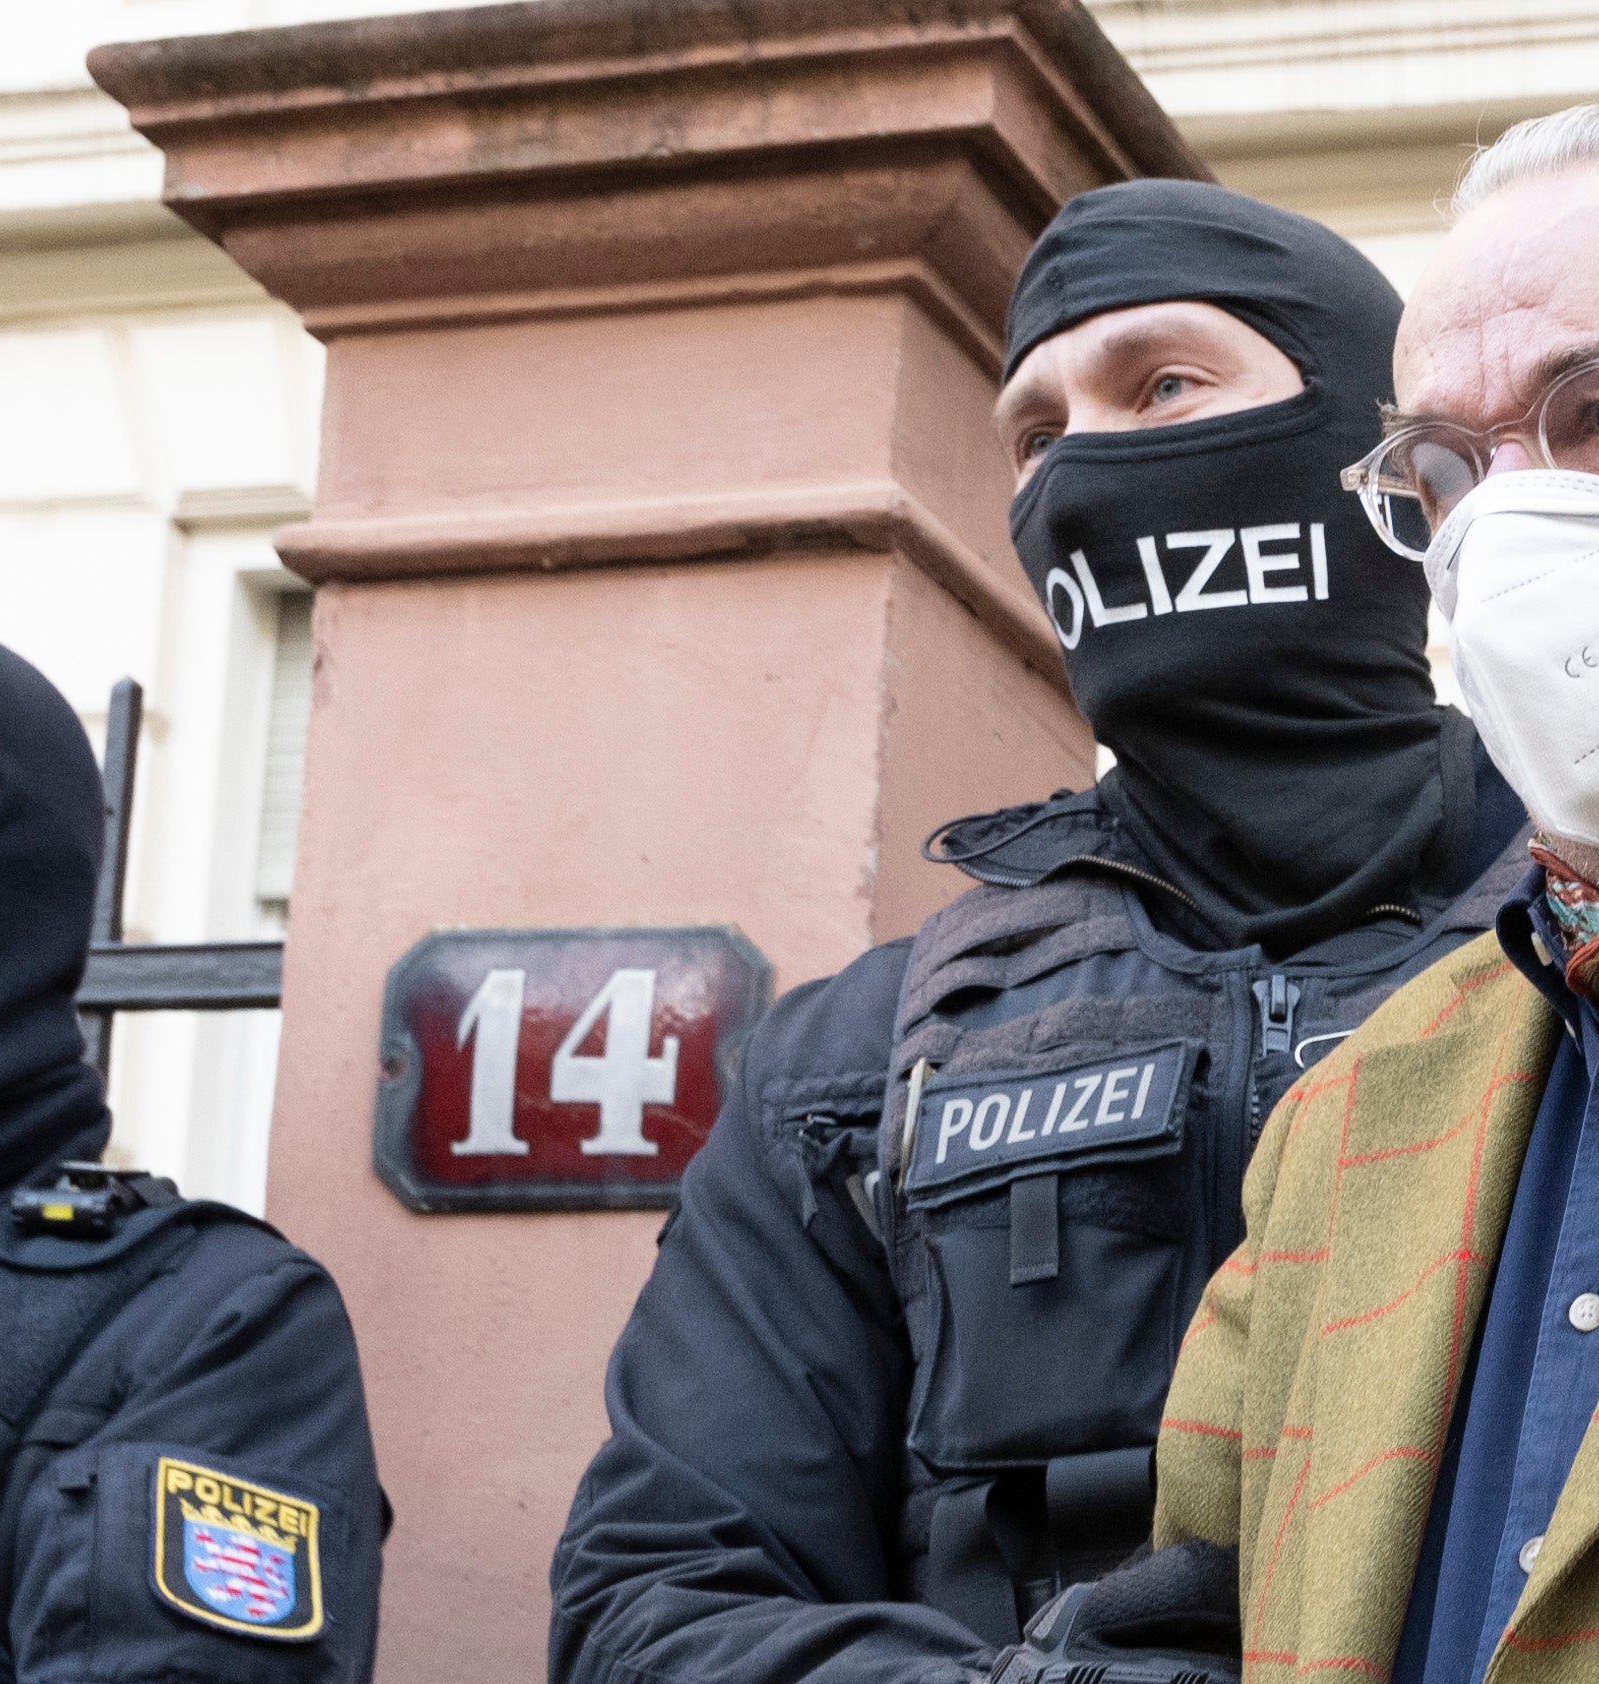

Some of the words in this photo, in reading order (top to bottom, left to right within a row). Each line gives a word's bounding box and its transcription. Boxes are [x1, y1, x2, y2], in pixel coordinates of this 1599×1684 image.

[449, 968, 681, 1157] 14
[934, 1062, 1157, 1165] POLIZEI
[166, 1468, 310, 1538] POLIZEI
